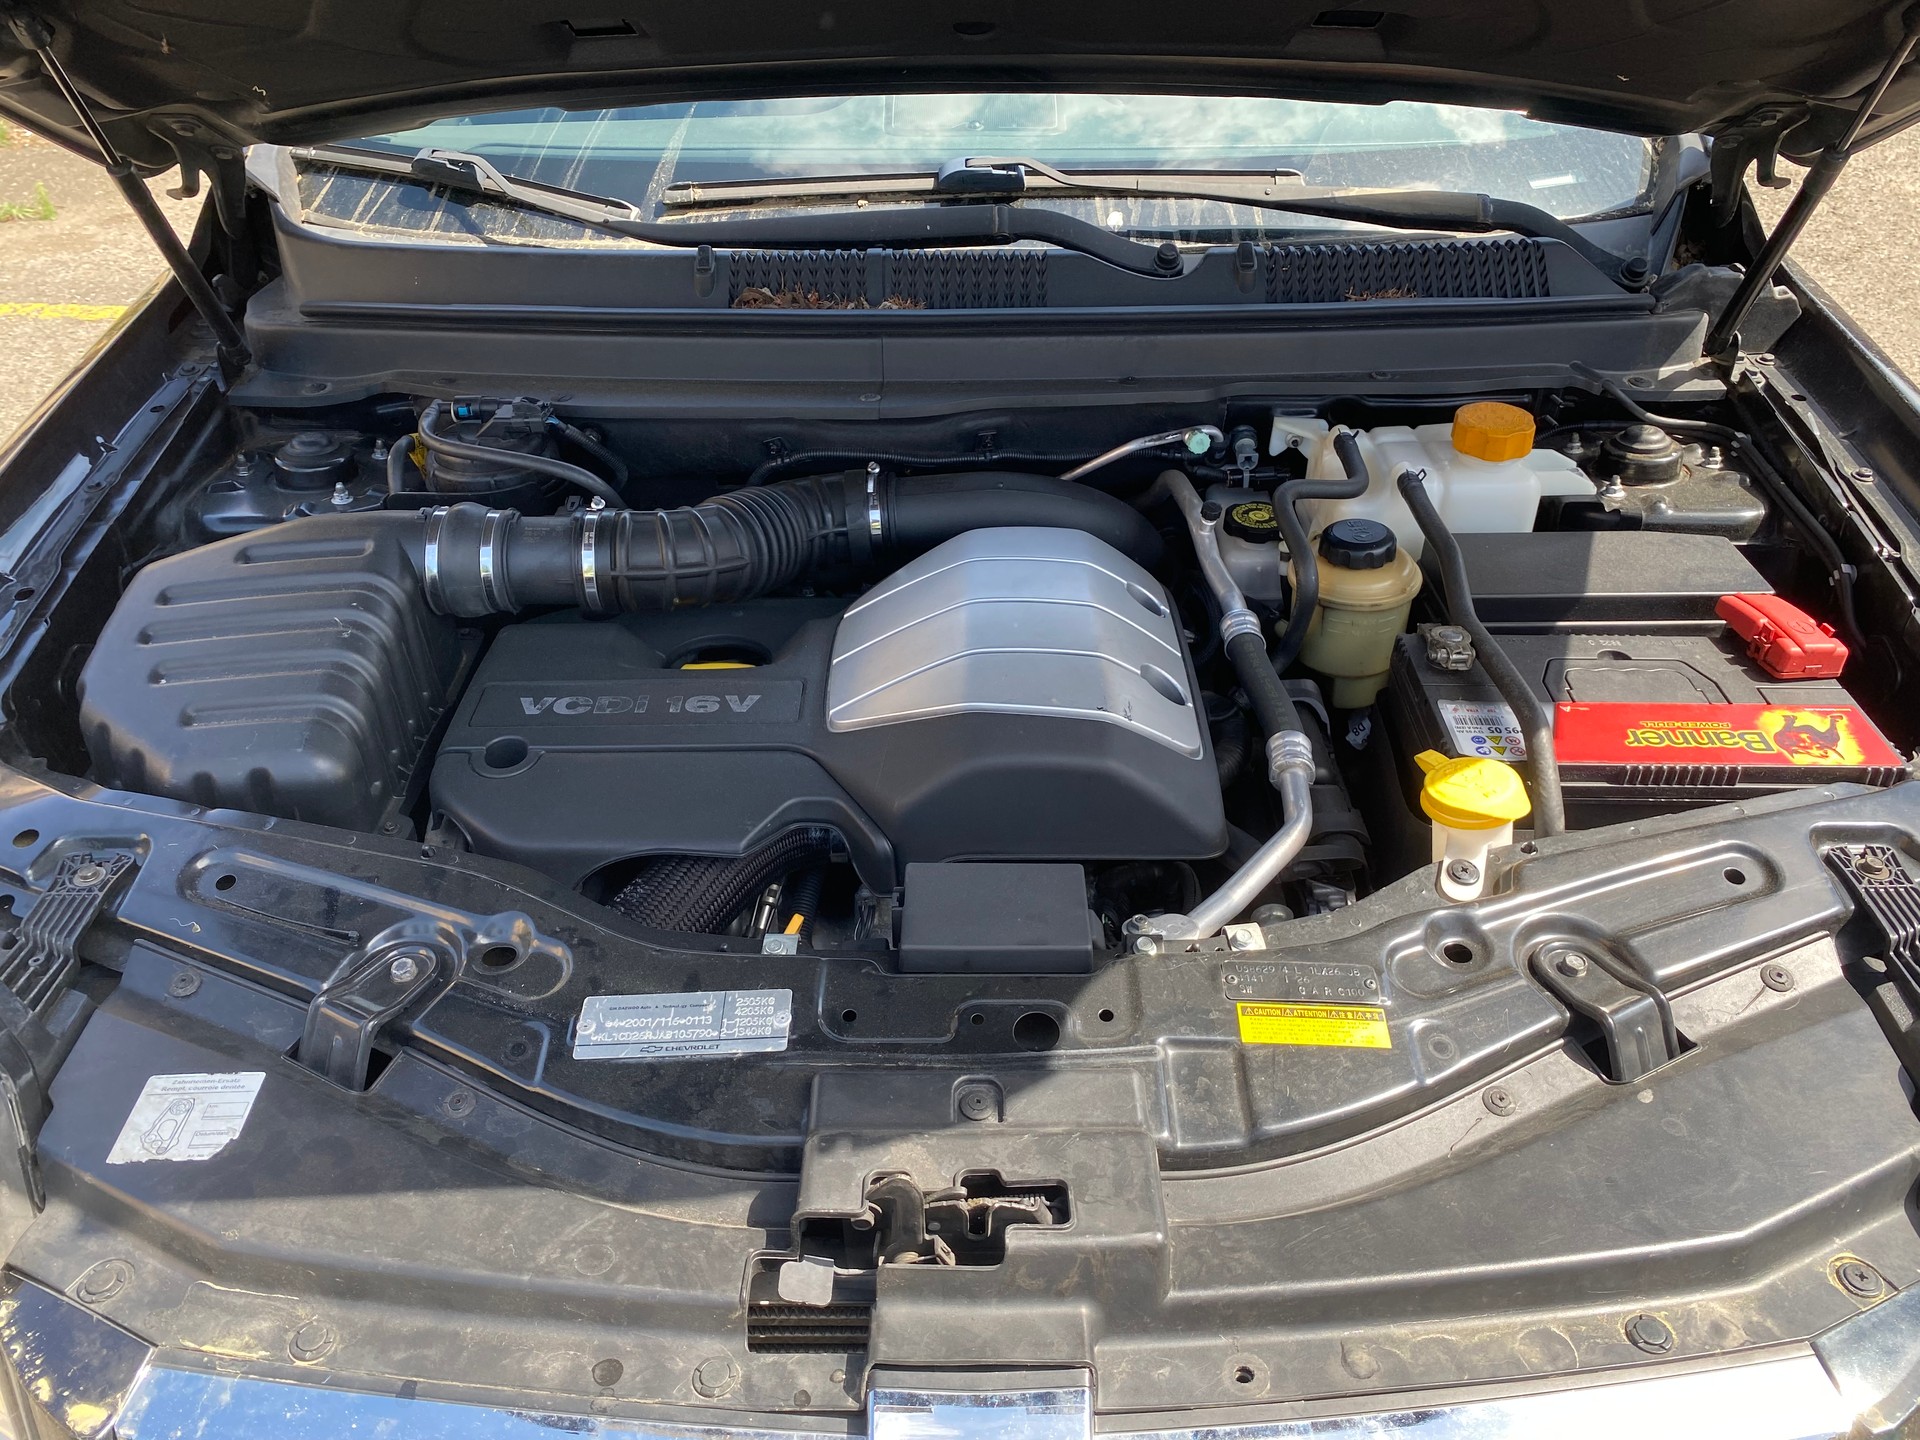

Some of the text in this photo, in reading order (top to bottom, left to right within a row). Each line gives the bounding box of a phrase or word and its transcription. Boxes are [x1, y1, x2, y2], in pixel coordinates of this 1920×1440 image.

[666, 694, 762, 714] 16V
[1352, 722, 1366, 736] D8
[1487, 726, 1522, 734] 95 05
[1625, 729, 1776, 753] Banner
[736, 997, 775, 1006] 2505KG
[734, 1006, 774, 1016] 4205KG
[1293, 1010, 1328, 1018] ATTENTION
